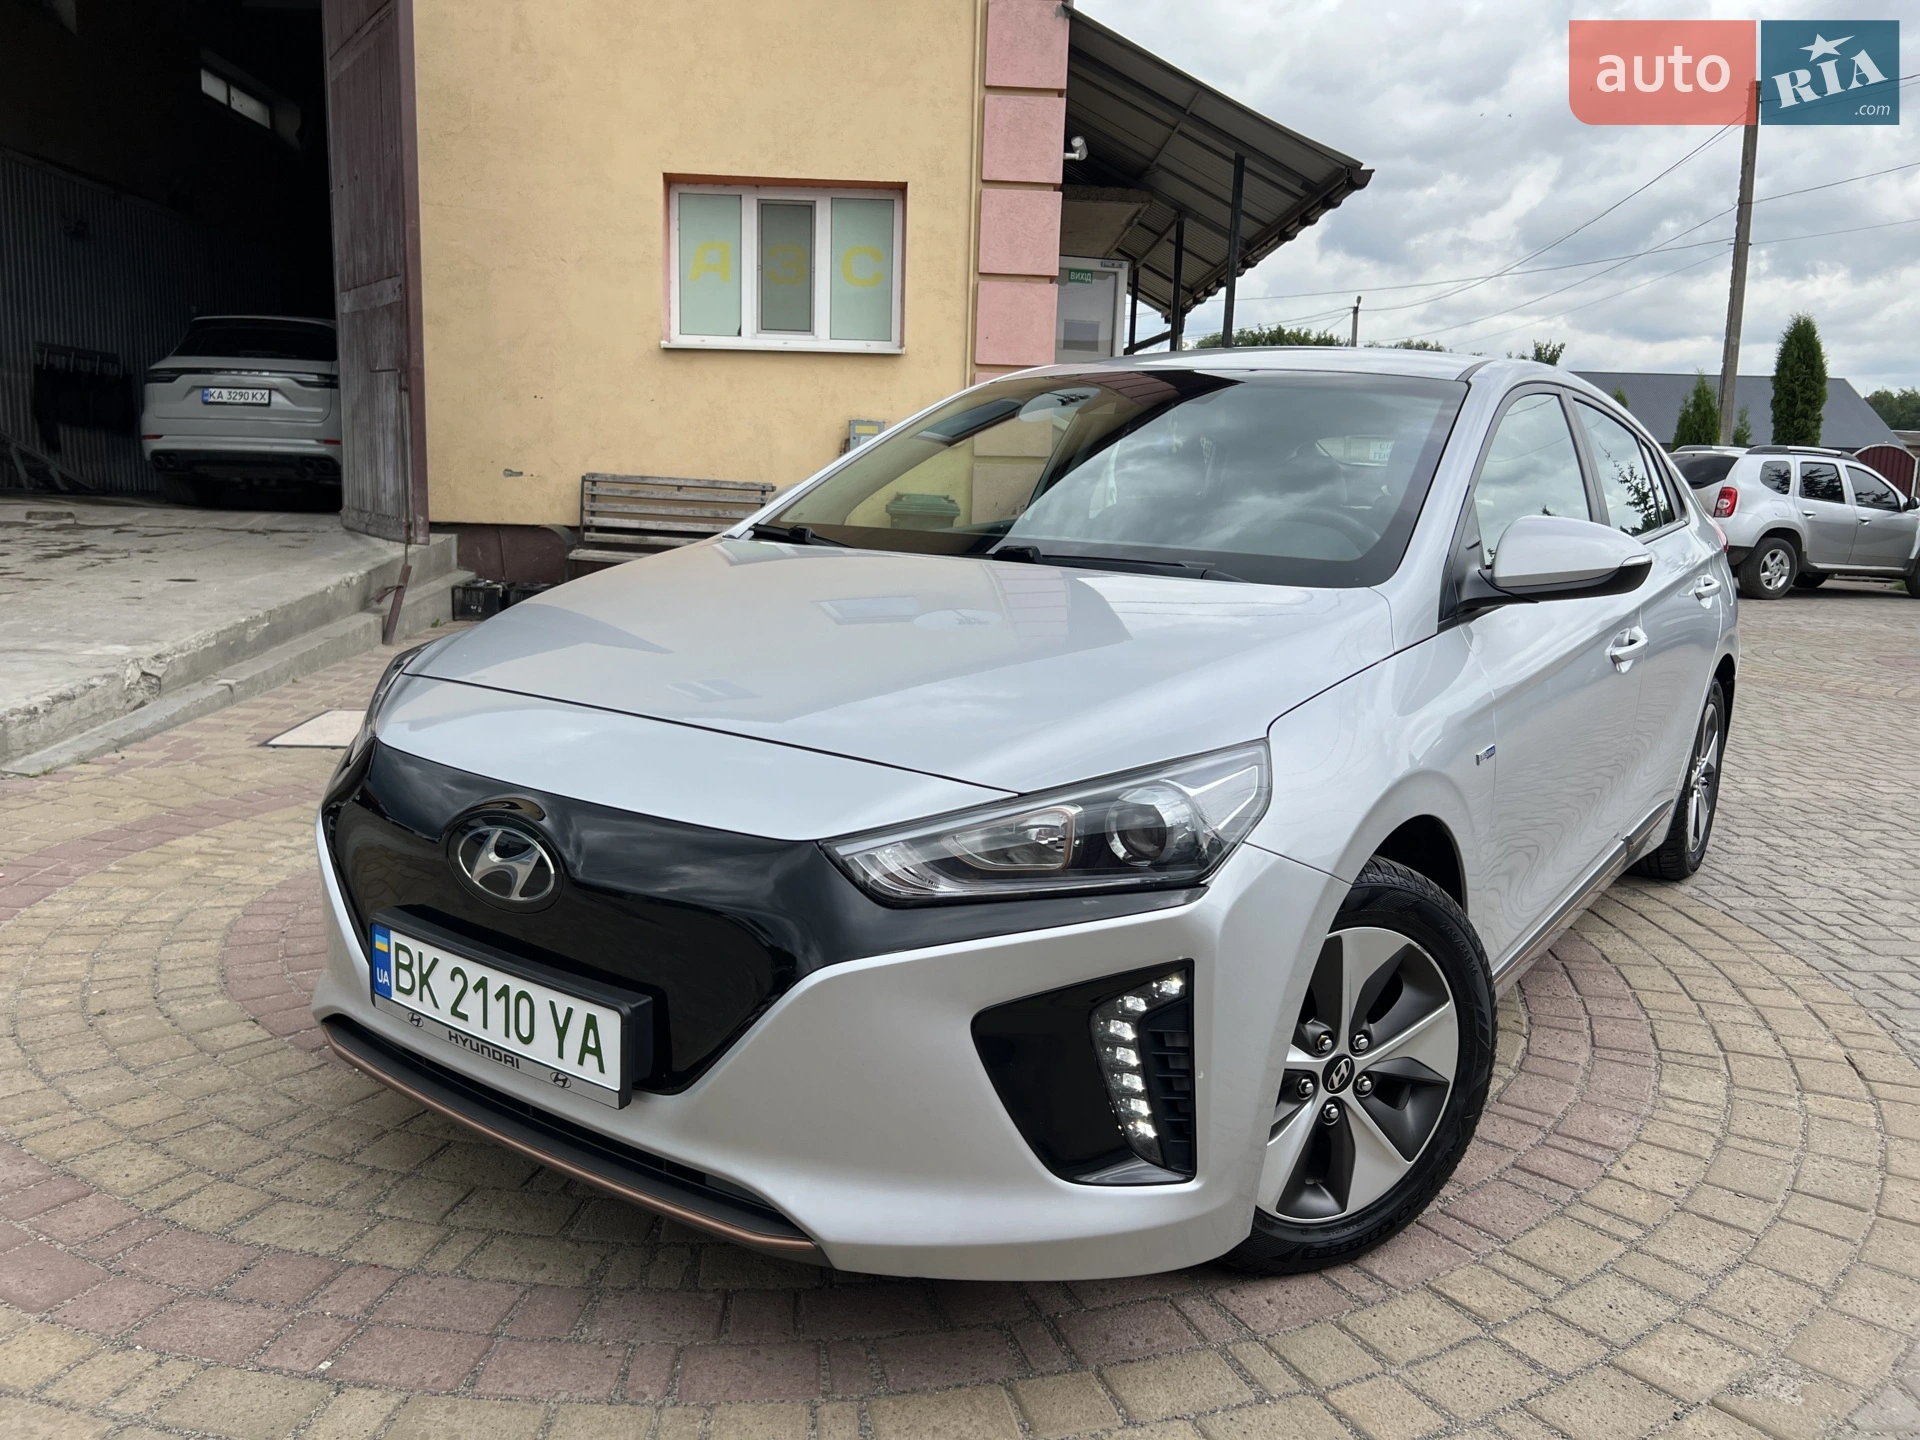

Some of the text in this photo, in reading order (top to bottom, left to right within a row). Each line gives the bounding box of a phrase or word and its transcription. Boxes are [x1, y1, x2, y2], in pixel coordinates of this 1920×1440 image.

[1070, 271, 1092, 282] ВИХІД
[209, 390, 267, 401] KA 3290 KX
[376, 966, 390, 987] UA
[394, 941, 605, 1074] BK 2110 YA
[448, 1030, 520, 1070] HYUNDAI
